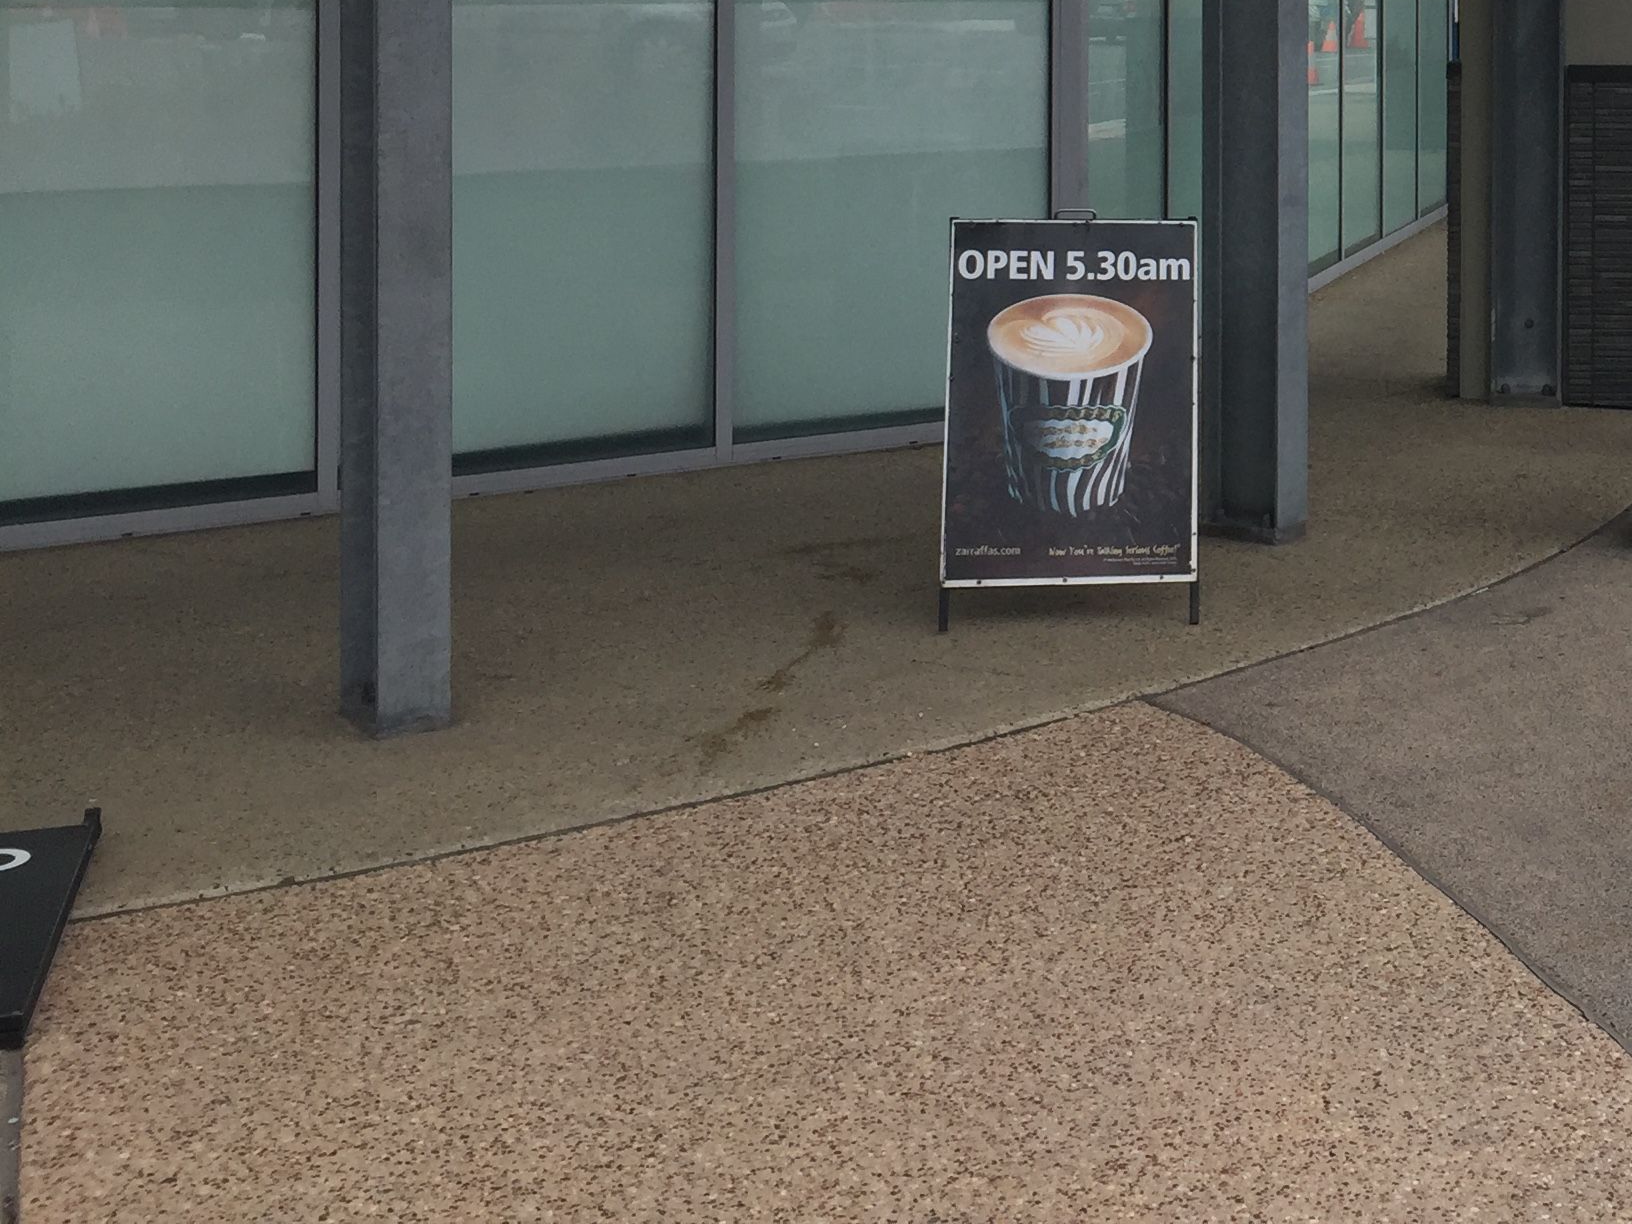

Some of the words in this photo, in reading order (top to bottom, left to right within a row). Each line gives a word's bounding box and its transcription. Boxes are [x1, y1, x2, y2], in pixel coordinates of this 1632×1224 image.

[957, 249, 1055, 280] OPEN
[1065, 250, 1191, 281] 5.30am
[1049, 547, 1067, 556] Now
